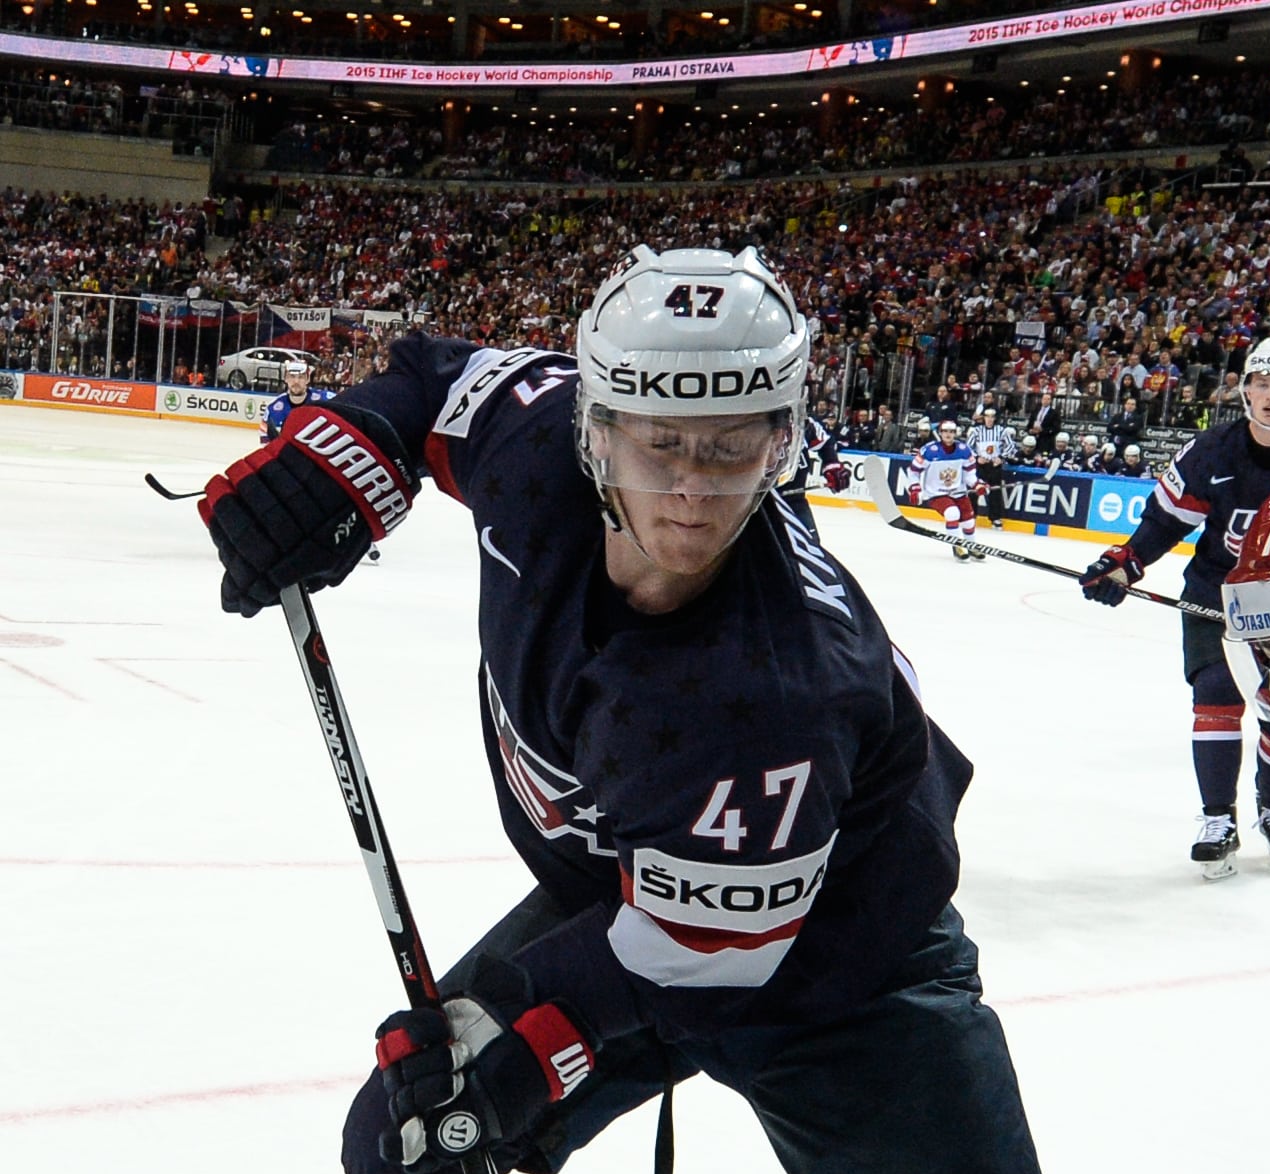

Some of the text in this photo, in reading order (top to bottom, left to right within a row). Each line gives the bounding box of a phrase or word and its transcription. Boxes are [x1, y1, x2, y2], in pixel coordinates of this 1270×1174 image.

[968, 27, 999, 43] 2015
[1001, 20, 1031, 38] IIHF
[1035, 17, 1059, 33] Ice
[1063, 10, 1117, 30] Hockey
[1122, 2, 1165, 22] World
[346, 66, 613, 83] 2015 IIHF Ice Hockey World Championship
[632, 62, 734, 78] PRAHA OSTRAVA
[287, 309, 326, 322] OSTAŠOV
[664, 284, 725, 318] 47
[444, 352, 537, 427] ODA
[611, 362, 775, 399] ŠKODA
[186, 394, 239, 414] ŠKODA
[1001, 480, 1079, 518] MEN
[315, 685, 363, 816] DYNASTY
[690, 760, 812, 852] 47
